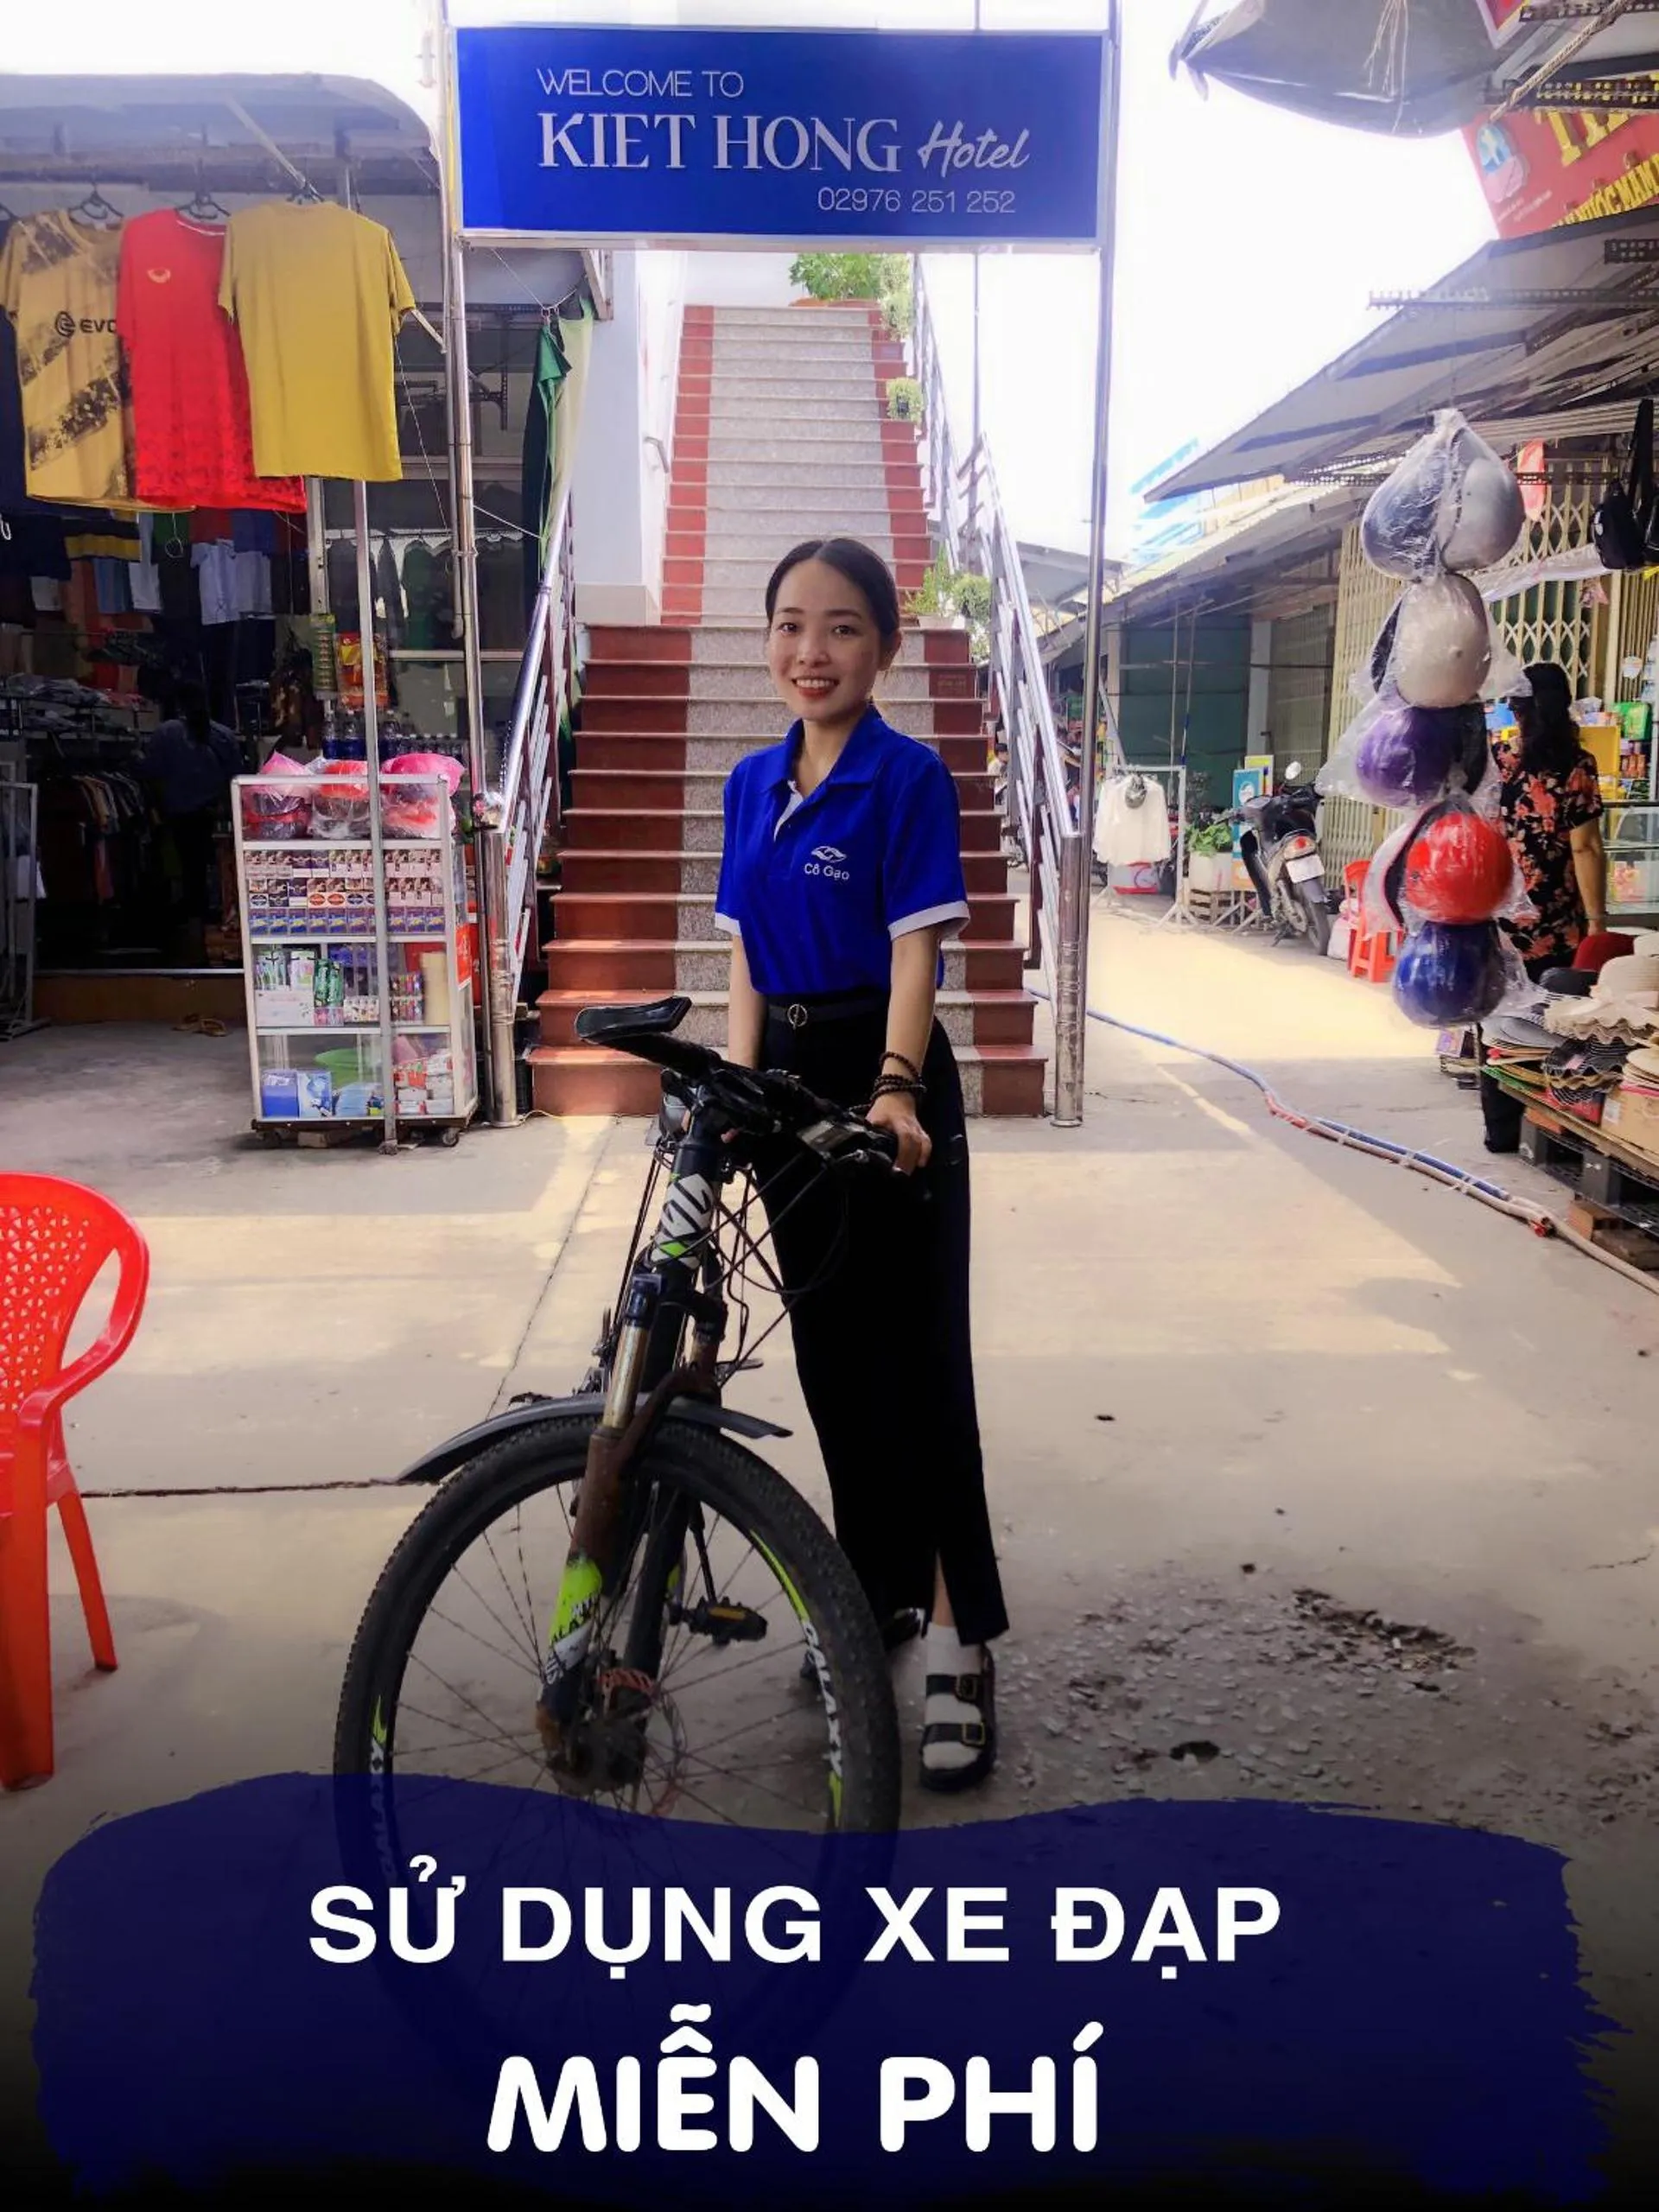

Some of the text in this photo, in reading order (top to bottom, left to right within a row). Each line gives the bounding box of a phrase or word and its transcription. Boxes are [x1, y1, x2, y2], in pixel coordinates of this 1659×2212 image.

[536, 68, 745, 98] WELCOME TO
[537, 112, 1031, 178] KIET HONG Hotel
[817, 187, 1016, 213] 02976 251 252
